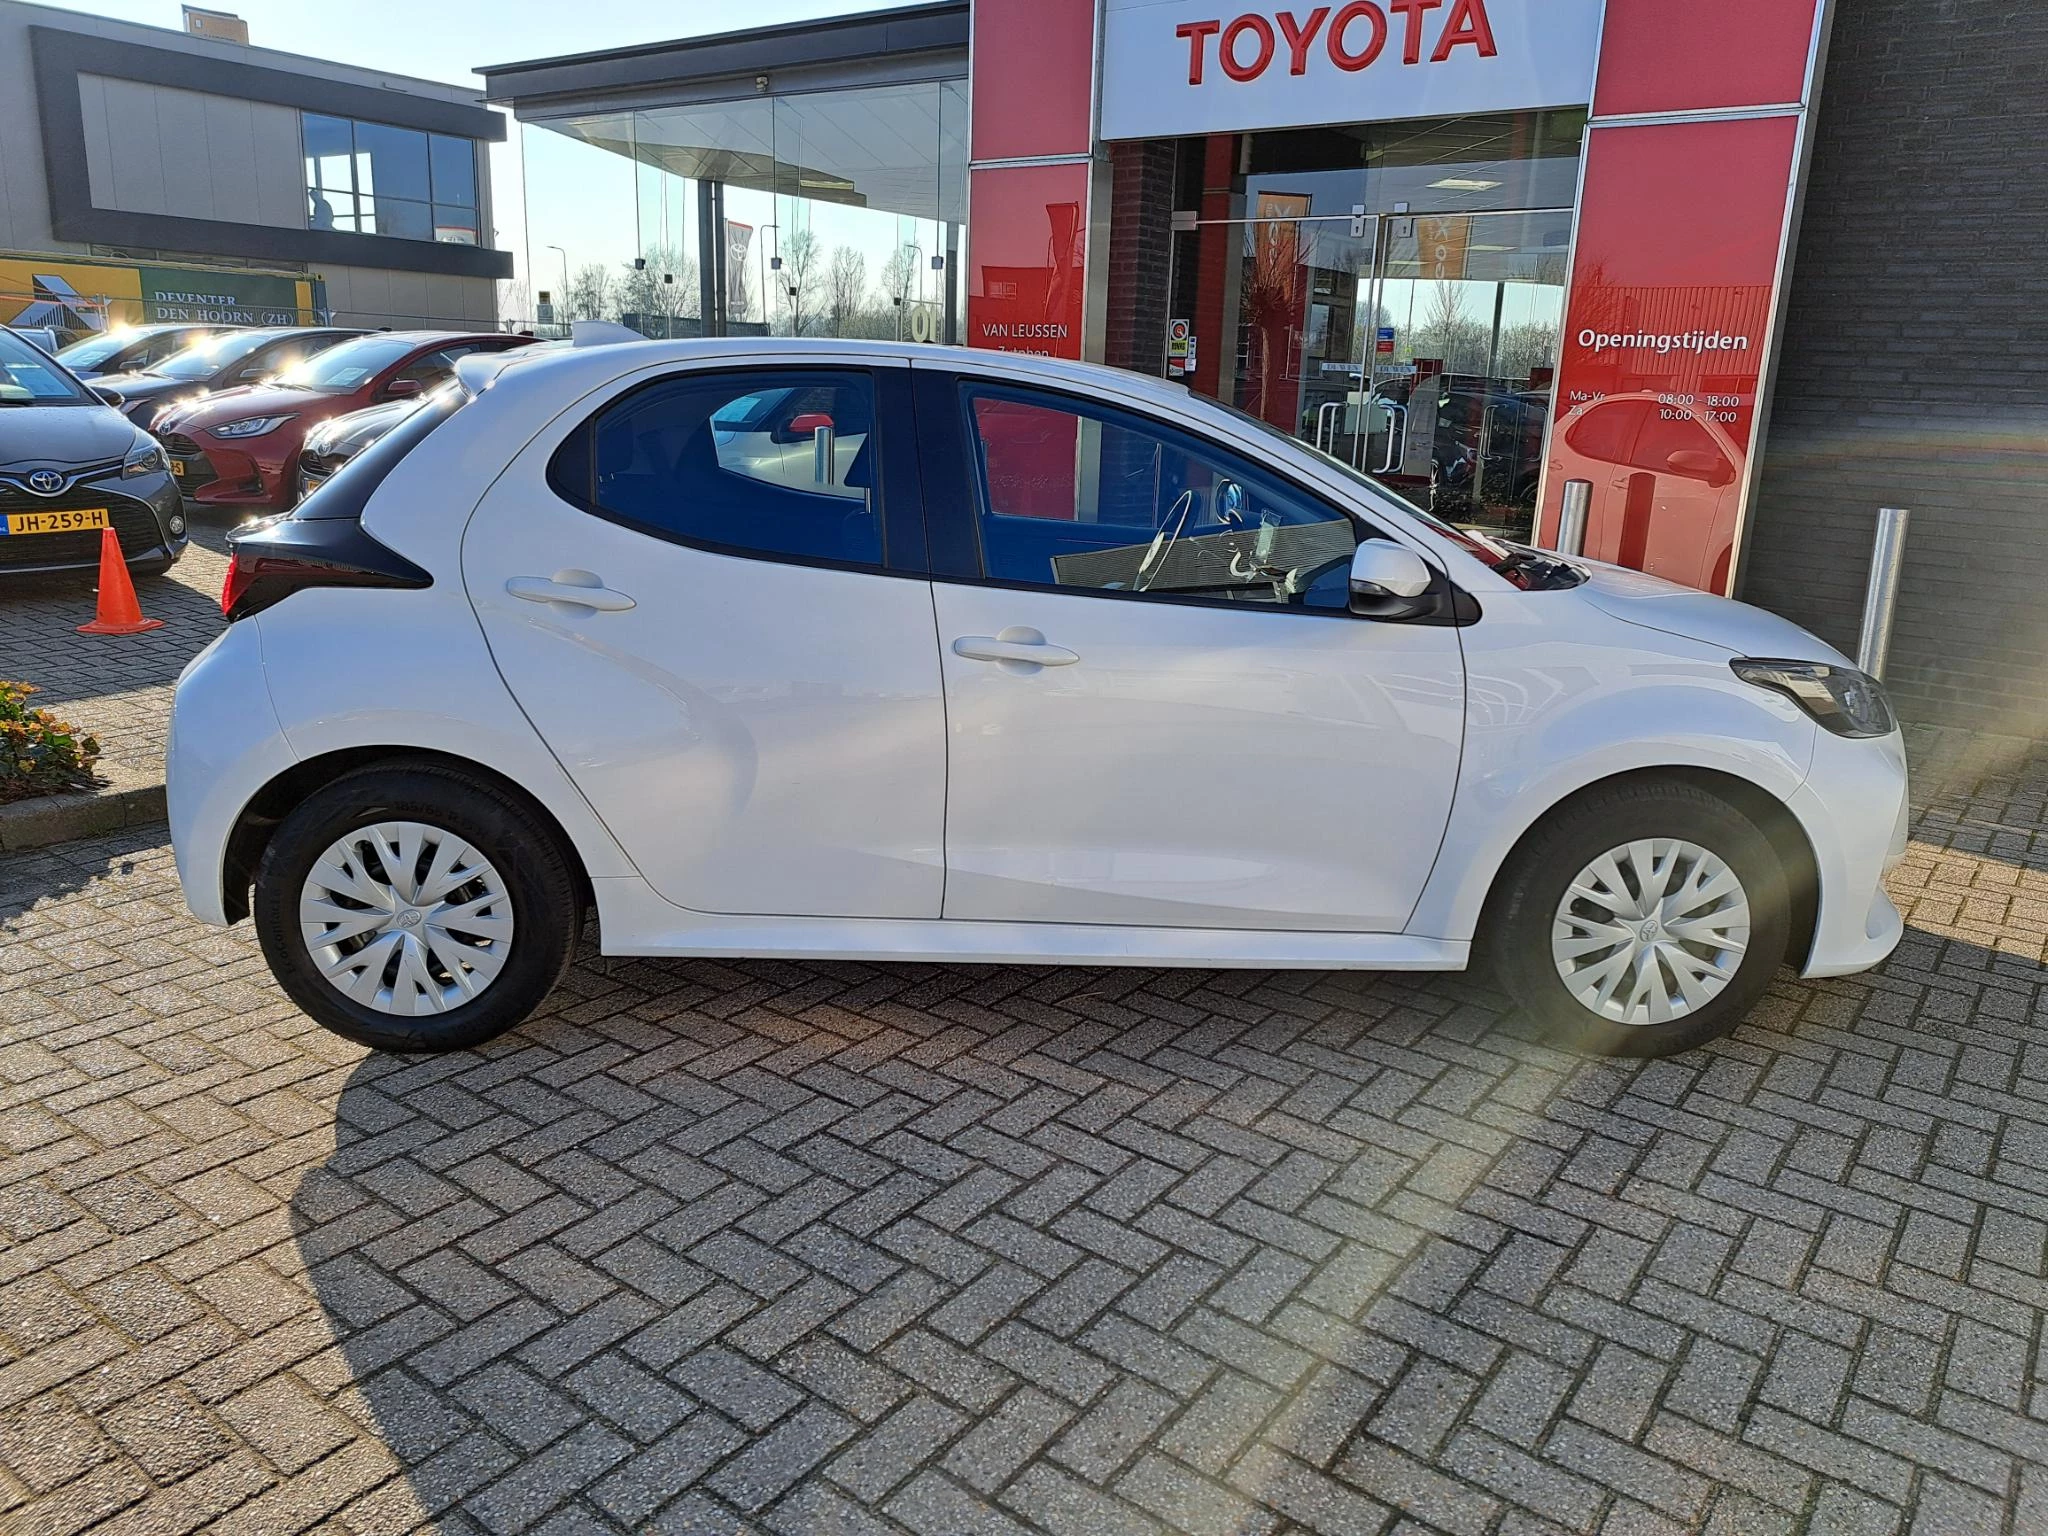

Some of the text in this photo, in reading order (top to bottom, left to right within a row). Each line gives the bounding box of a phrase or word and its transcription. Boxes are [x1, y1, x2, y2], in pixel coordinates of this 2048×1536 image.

[1176, 0, 1498, 85] TOYOTA
[154, 291, 236, 305] DEVENTER
[156, 307, 295, 326] DEN HOORN (ZH)
[982, 323, 1067, 338] VAN LEUSSEN
[1578, 328, 1748, 355] Openingstijden
[1569, 390, 1606, 401] Ma-Vr
[1658, 394, 1694, 405] 08:00
[1706, 395, 1739, 407] 18:00
[1568, 405, 1584, 416] Za
[1659, 409, 1692, 420] 10:00
[1704, 411, 1737, 423] 17:00
[16, 511, 104, 532] JH-259-H
